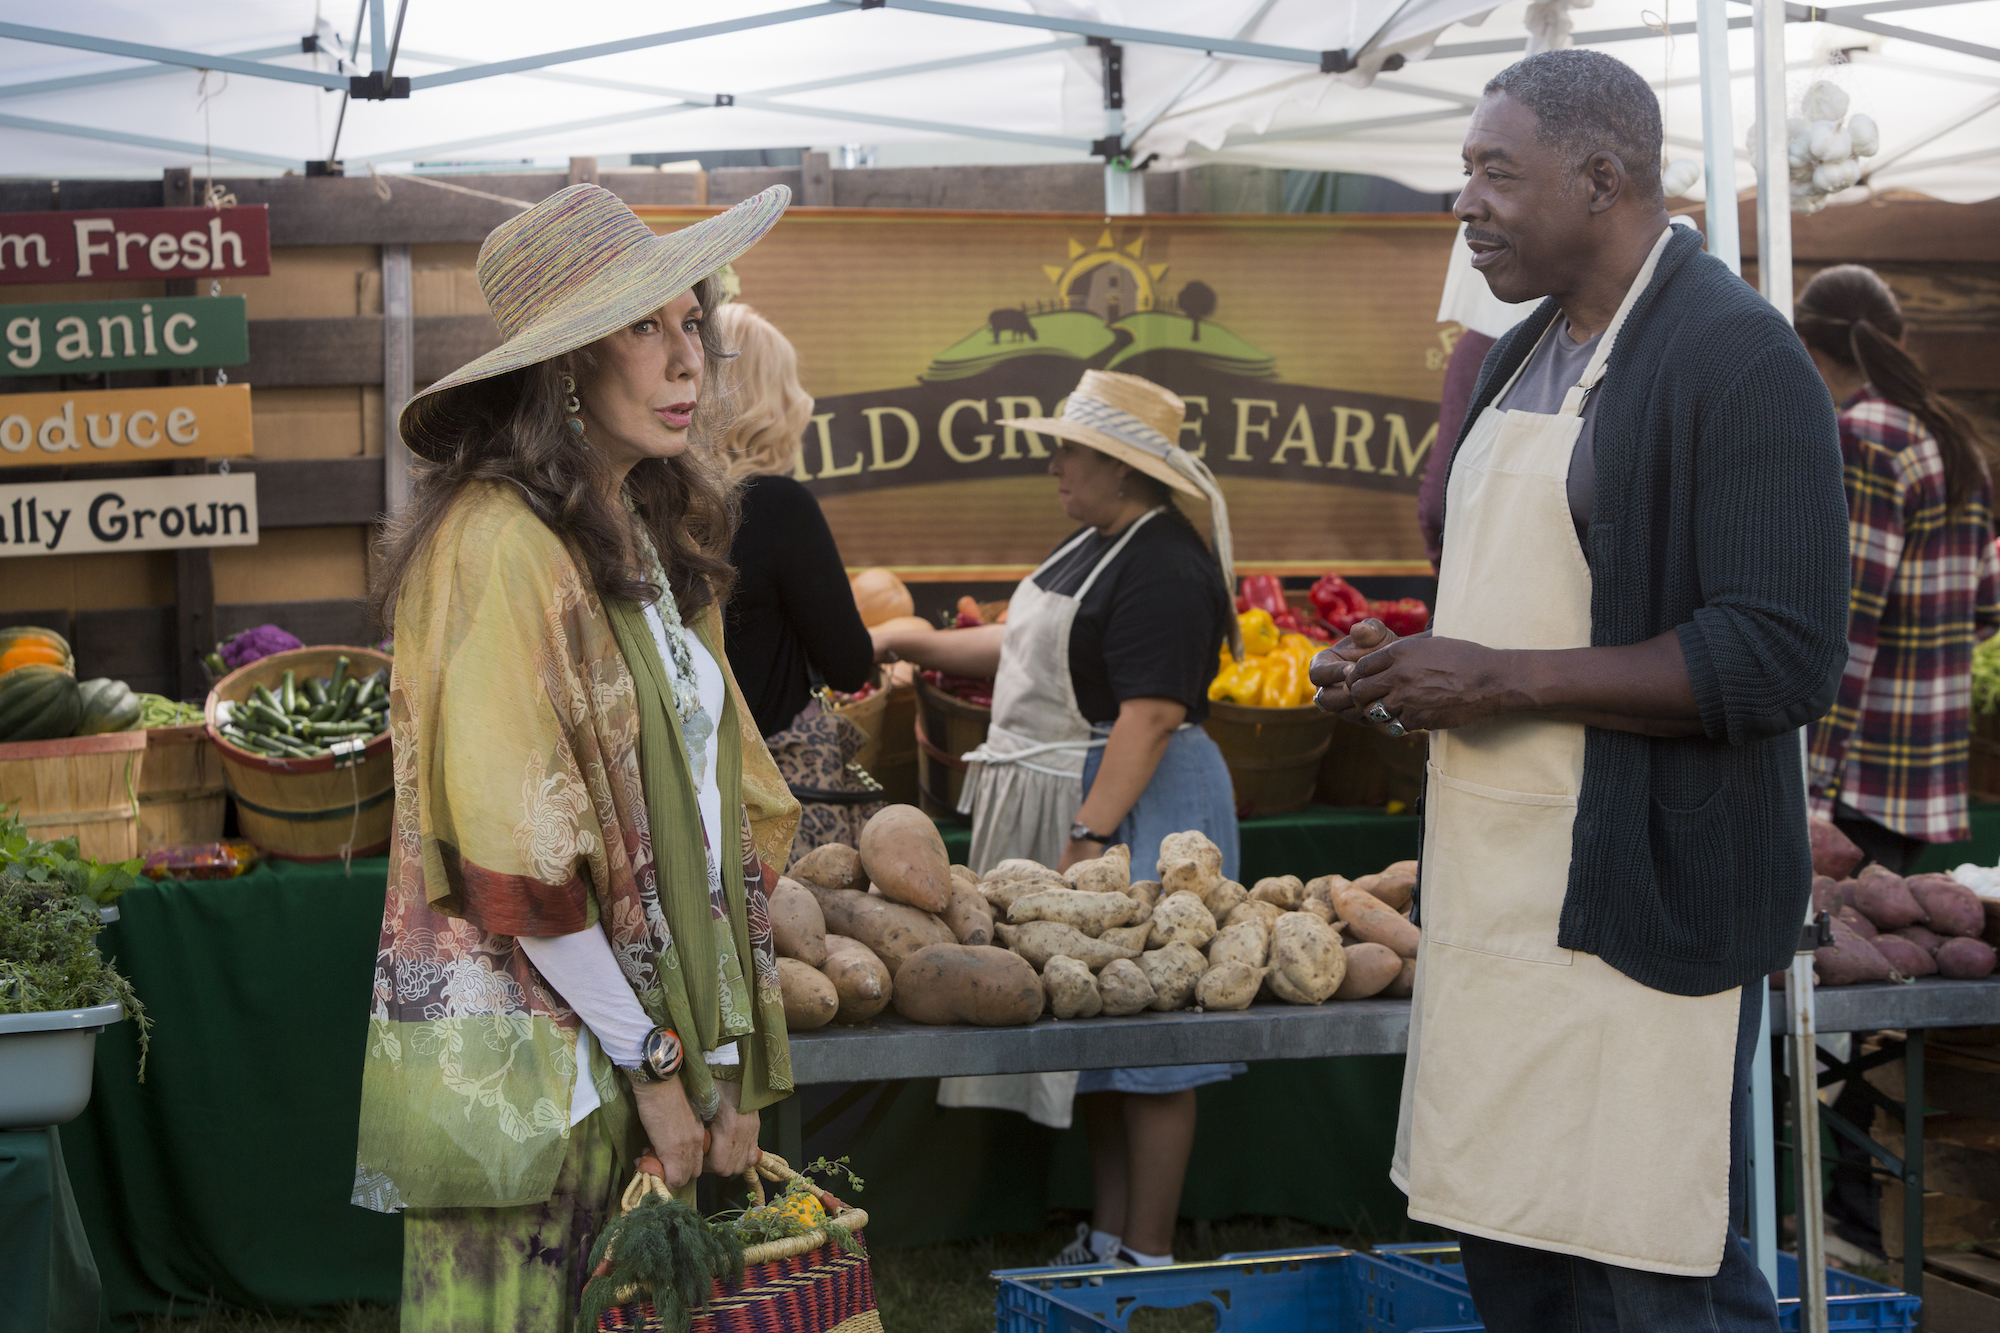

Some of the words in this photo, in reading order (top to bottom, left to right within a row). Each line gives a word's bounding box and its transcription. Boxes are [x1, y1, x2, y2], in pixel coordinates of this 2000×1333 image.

[73, 217, 246, 277] Fresh
[6, 304, 199, 368] ganic
[0, 401, 199, 452] oduce
[0, 496, 71, 550] lly
[88, 493, 249, 542] Grown
